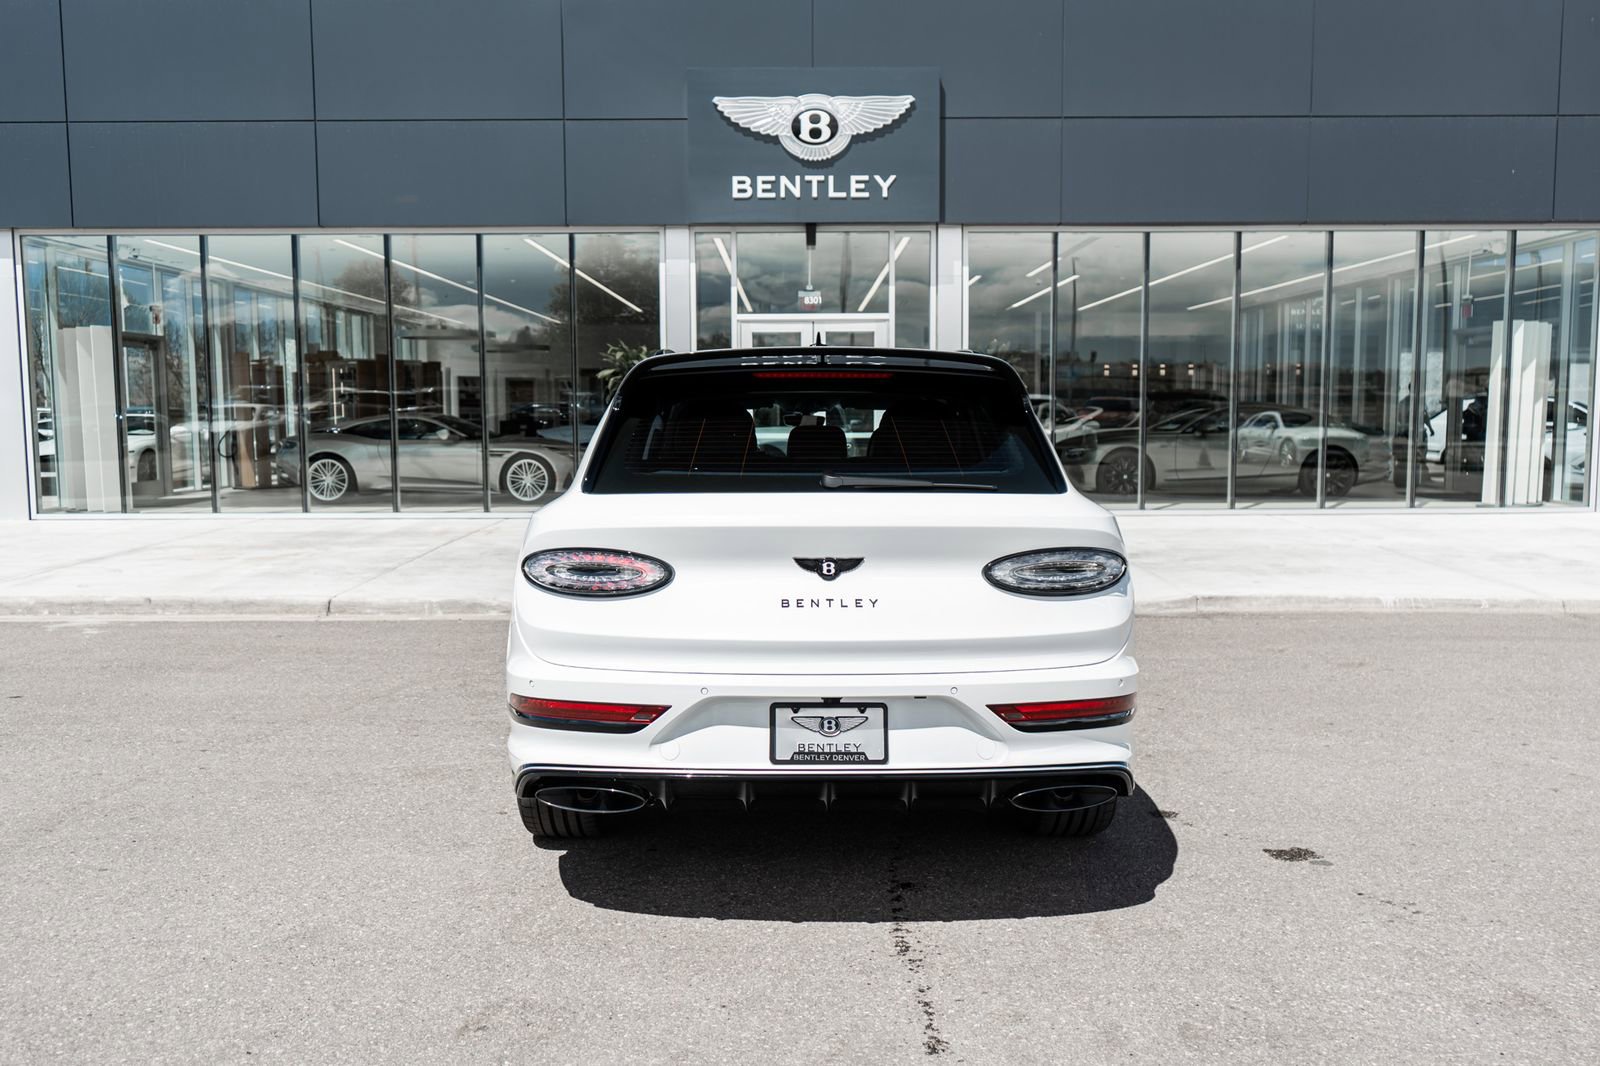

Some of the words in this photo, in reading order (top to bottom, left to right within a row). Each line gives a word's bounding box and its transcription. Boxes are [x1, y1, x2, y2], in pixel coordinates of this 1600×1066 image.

[732, 175, 897, 198] BENTLEY
[804, 296, 822, 304] 8301
[781, 599, 879, 608] BENTLEY
[797, 743, 862, 752] BENTLEY
